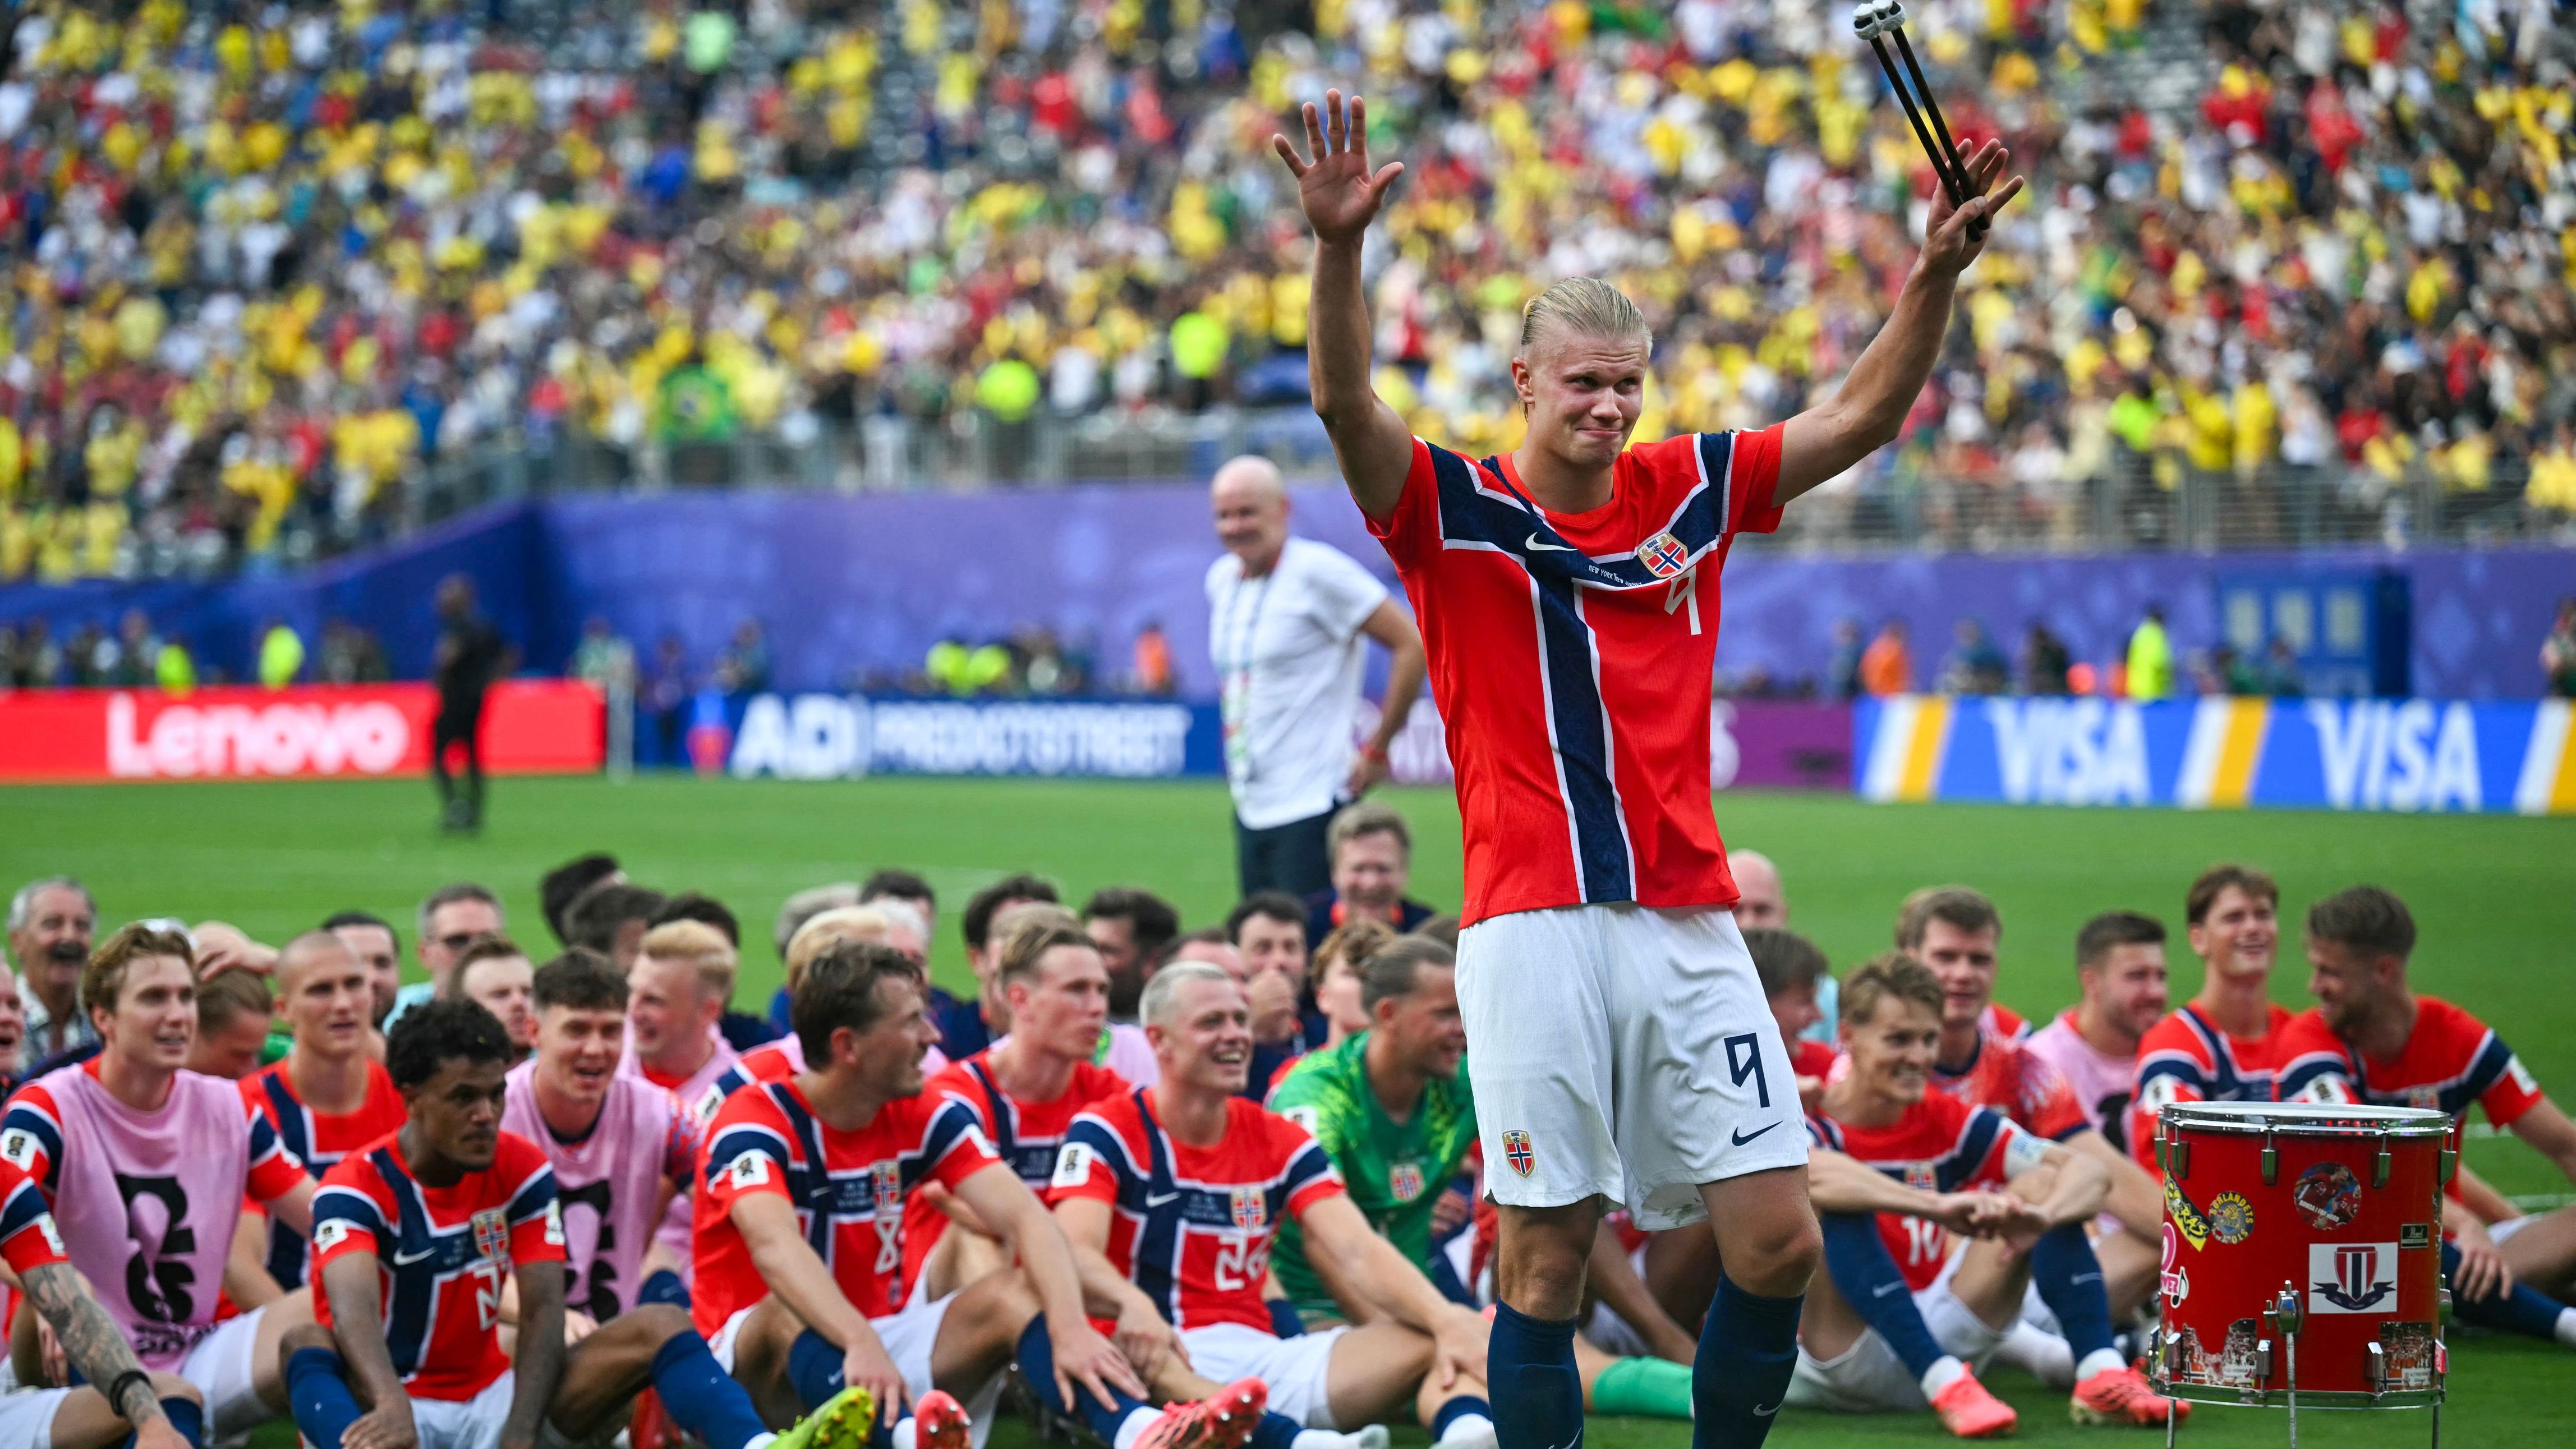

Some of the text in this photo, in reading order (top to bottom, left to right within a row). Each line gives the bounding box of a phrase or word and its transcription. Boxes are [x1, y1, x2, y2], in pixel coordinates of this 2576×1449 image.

[1588, 564, 1600, 574] NEW
[1600, 569, 1613, 580] YORK
[1646, 539, 1659, 549] NORGE
[1664, 564, 1702, 636] 9
[105, 691, 411, 778] Lenovo
[1986, 696, 2151, 806] VISA
[2303, 697, 2484, 812] VISA
[1724, 1032, 1770, 1108] 9
[873, 1215, 903, 1275] 8
[1901, 1215, 1947, 1267] 10
[473, 1264, 507, 1332] 2
